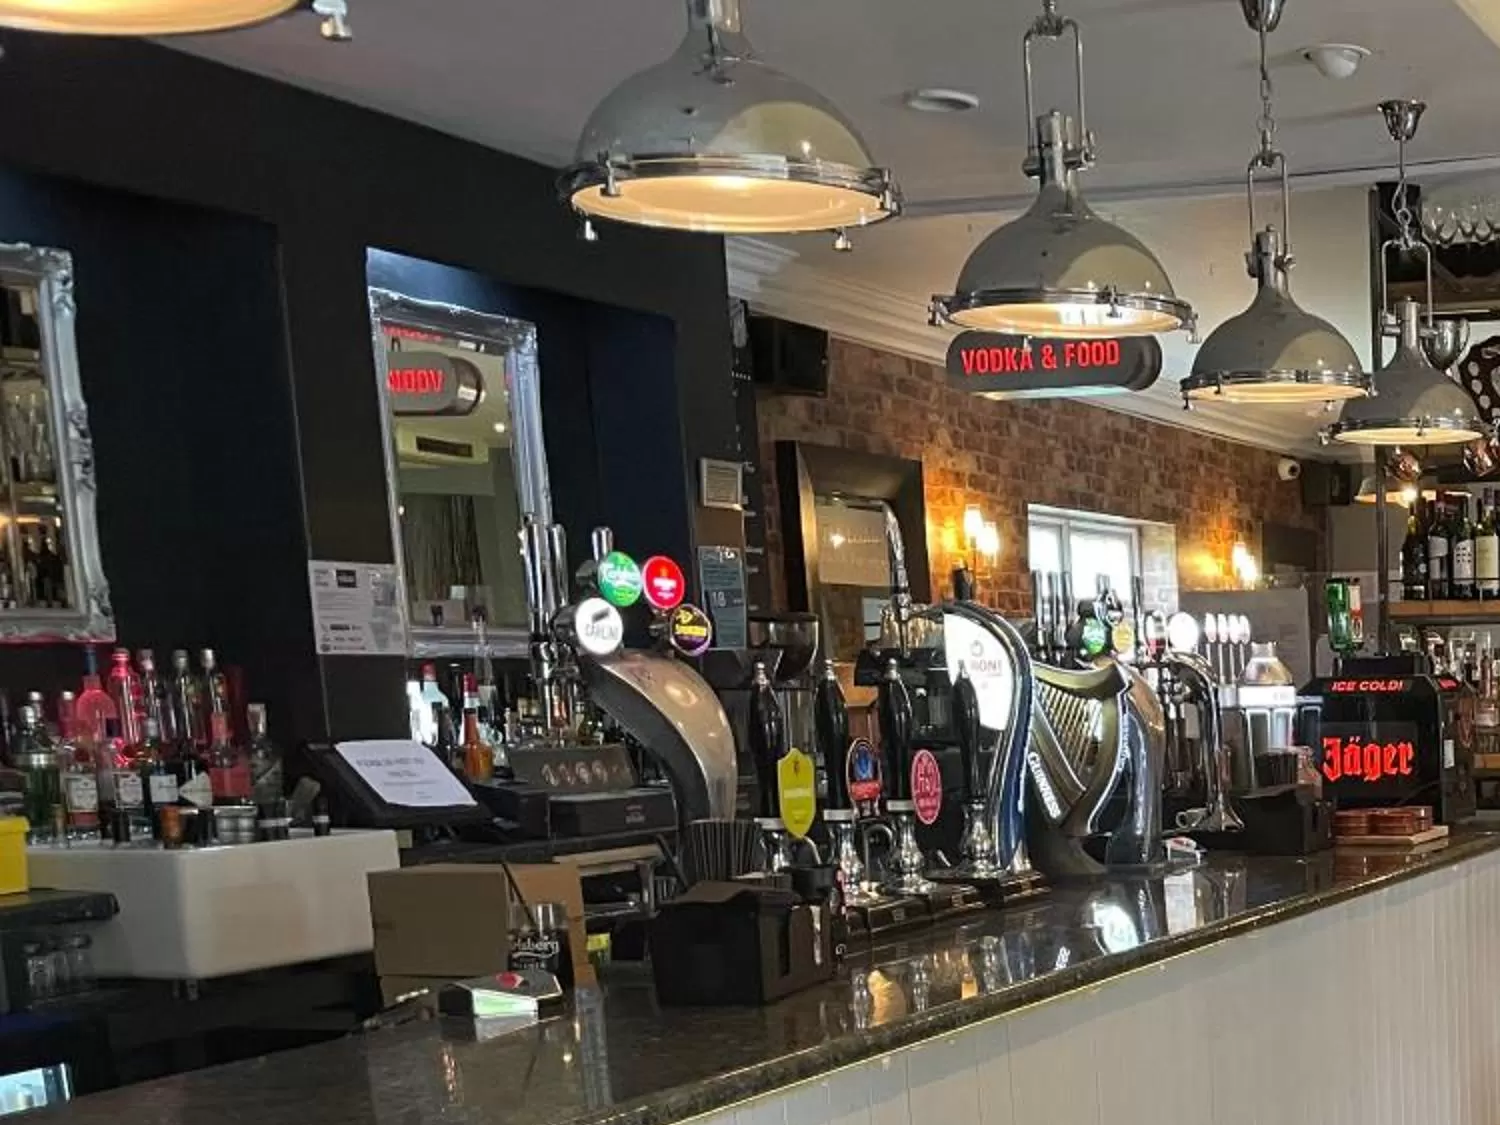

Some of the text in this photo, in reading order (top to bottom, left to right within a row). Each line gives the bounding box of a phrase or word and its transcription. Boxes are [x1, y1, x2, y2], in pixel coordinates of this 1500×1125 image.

[961, 339, 1121, 376] VODKA & FOOD
[1331, 681, 1355, 691] ICE
[1322, 735, 1414, 782] Jäger
